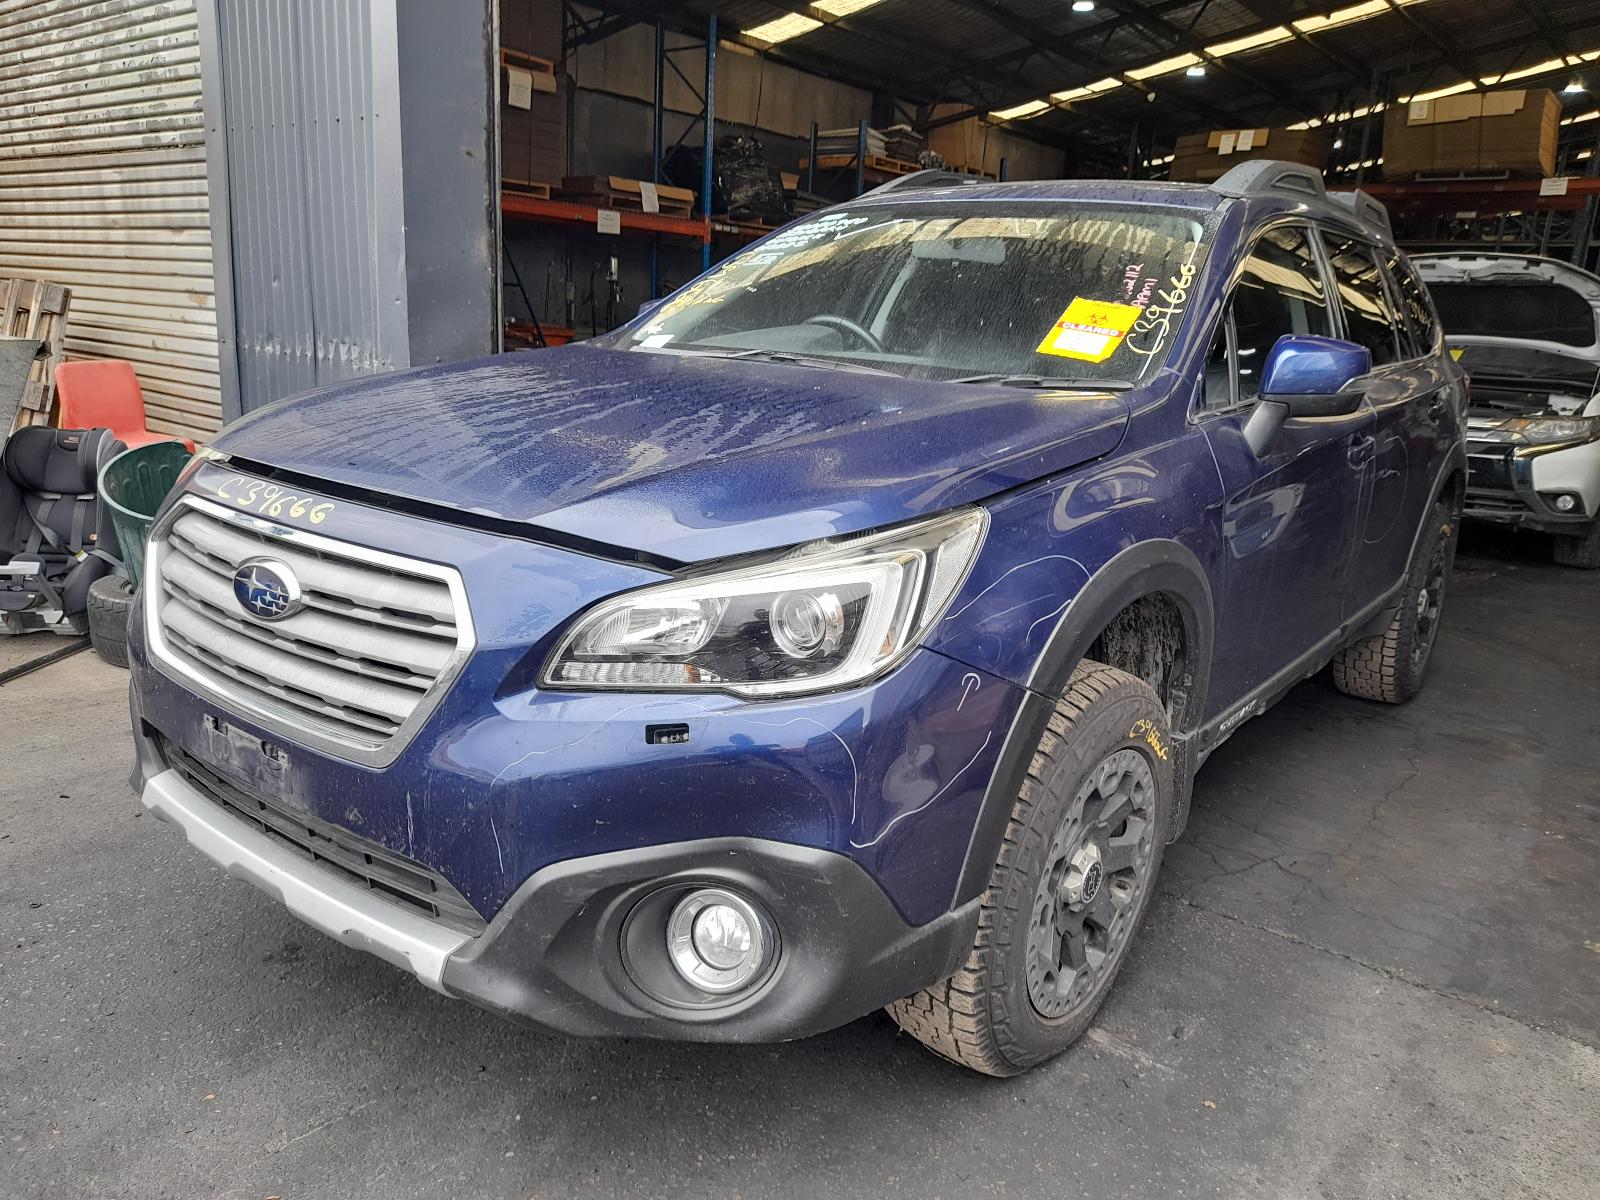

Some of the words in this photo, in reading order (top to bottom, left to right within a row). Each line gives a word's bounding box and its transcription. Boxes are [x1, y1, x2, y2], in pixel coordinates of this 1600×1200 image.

[1061, 322, 1120, 337] CLEARED
[1126, 263, 1197, 355] C39666
[217, 477, 336, 525] C39666
